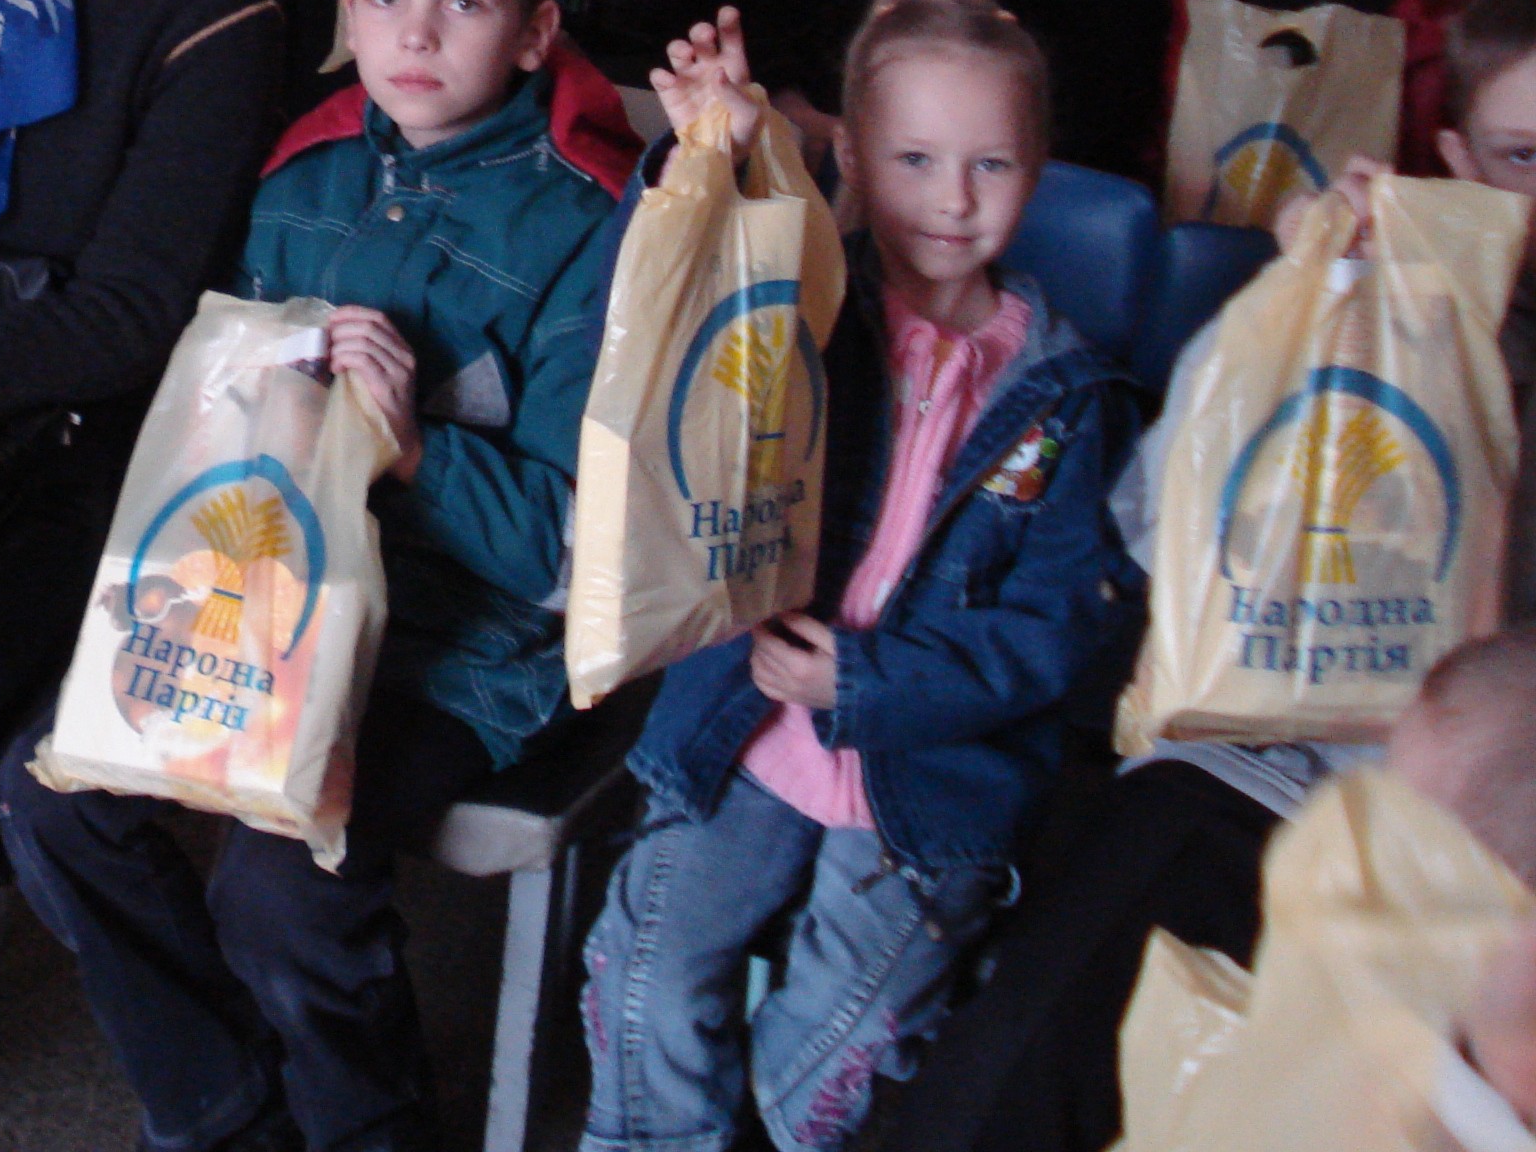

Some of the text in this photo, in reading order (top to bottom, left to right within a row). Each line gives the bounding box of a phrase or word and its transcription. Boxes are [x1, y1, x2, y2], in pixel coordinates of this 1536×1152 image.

[1228, 585, 1436, 626] Народна
[122, 619, 275, 696] Народна
[1237, 632, 1411, 685] Партія
